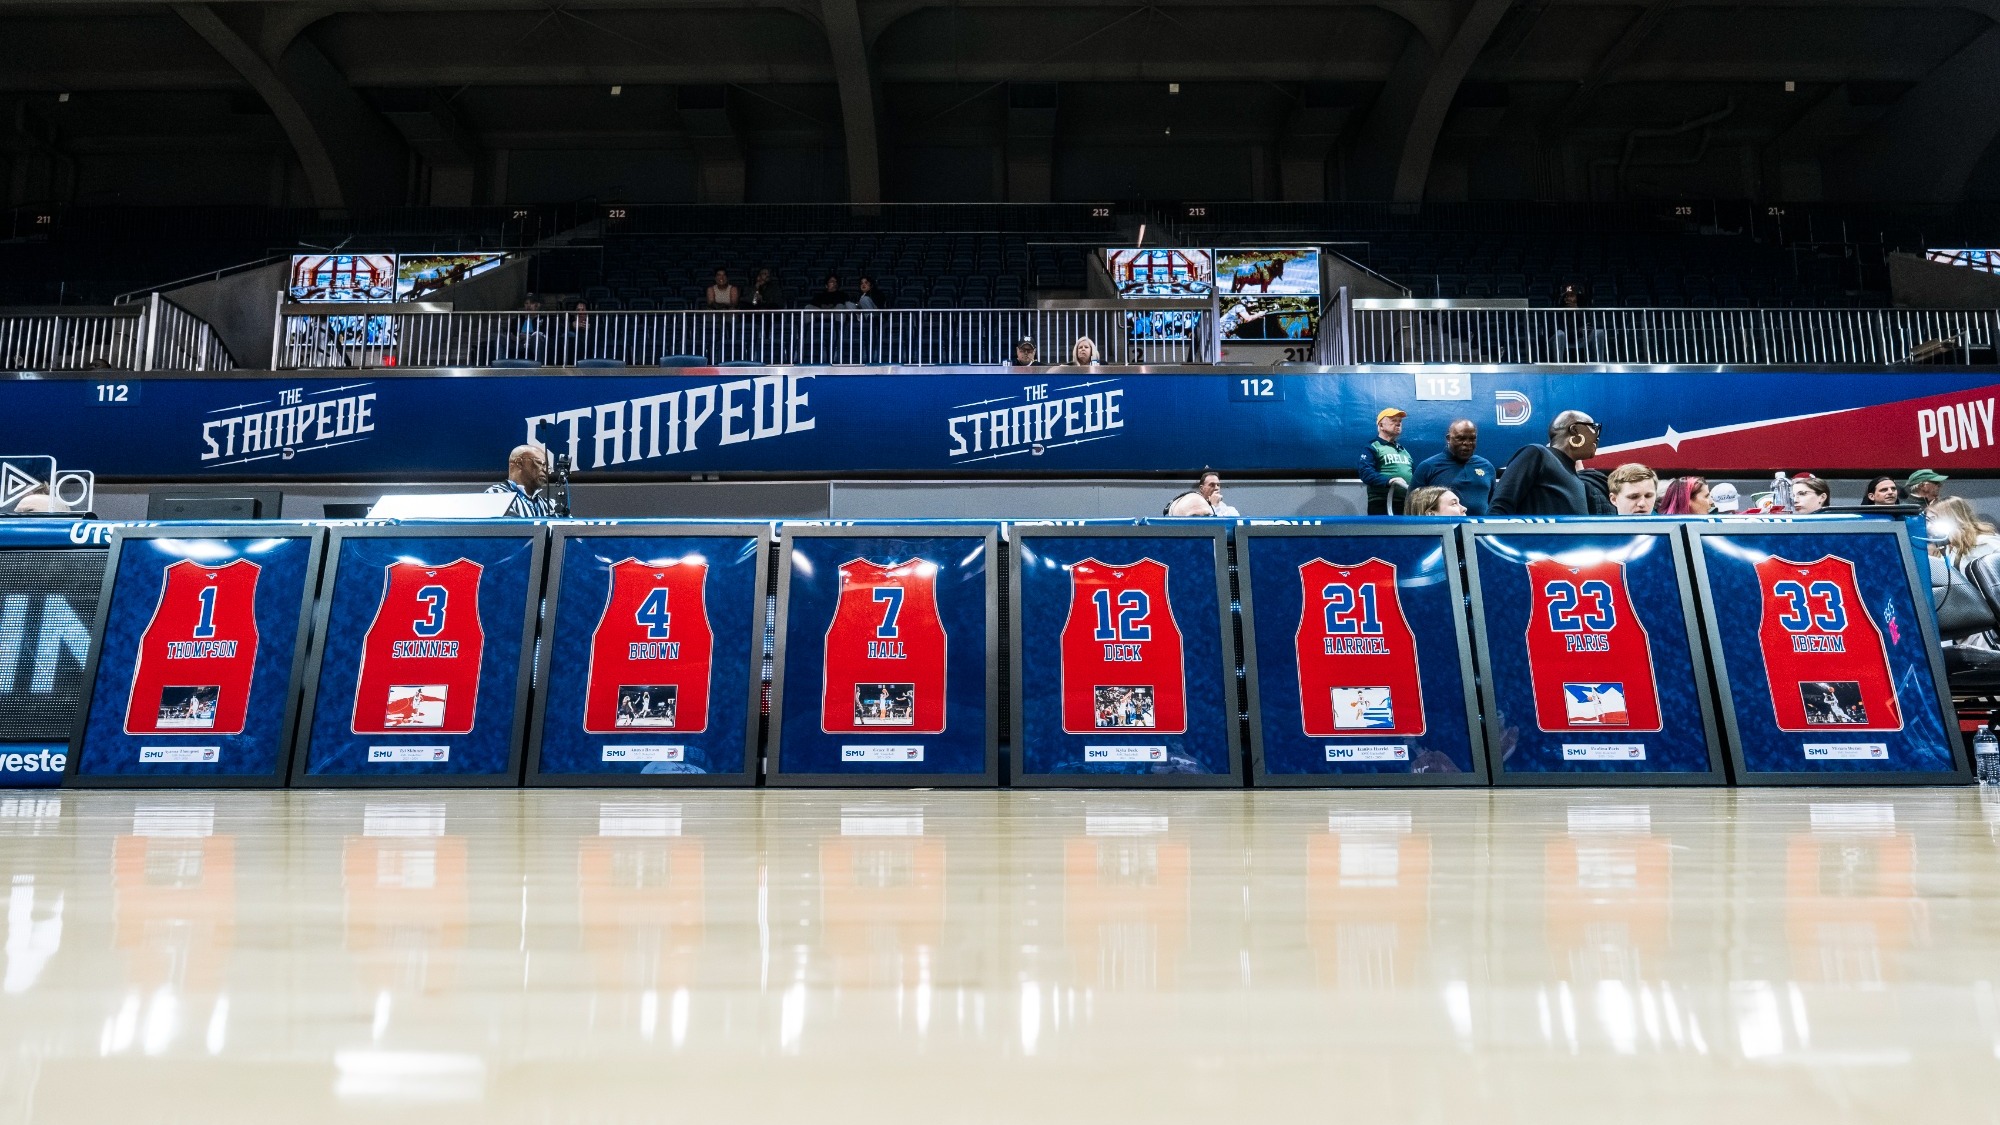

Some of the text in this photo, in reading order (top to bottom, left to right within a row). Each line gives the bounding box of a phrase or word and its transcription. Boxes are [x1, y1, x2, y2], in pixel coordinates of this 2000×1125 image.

[36, 215, 51, 224] 211
[609, 209, 625, 218] 212
[1092, 208, 1109, 217] 212
[1189, 207, 1206, 216] 213
[1676, 206, 1692, 215] 213
[97, 384, 129, 402] 112
[1023, 383, 1049, 402] THE
[1240, 379, 1274, 396] 112
[1427, 378, 1461, 396] 113
[278, 387, 304, 407] THE
[201, 393, 377, 461] STAMPEDE
[525, 374, 816, 473] STAMPEDE
[948, 389, 1124, 457] STAMPEDE
[1917, 397, 1995, 458] PONY
[193, 586, 218, 638] 1
[412, 585, 448, 637] 3
[635, 587, 671, 639] 4
[872, 586, 904, 638] 7
[1092, 588, 1151, 641] 12
[1322, 582, 1383, 634] 21
[1544, 580, 1617, 632] 23
[1773, 580, 1848, 632] 33
[167, 640, 238, 659] THOMPSON
[392, 640, 459, 659] SKINNER
[628, 642, 680, 660] BROWN
[867, 641, 907, 659] HALL
[1323, 637, 1390, 655] HARRIEL
[1565, 633, 1610, 652] PARIS
[1791, 634, 1846, 653] IBEZIM
[1104, 644, 1142, 662] DECK
[1328, 749, 1353, 757] SMU
[1567, 748, 1587, 756] SMU
